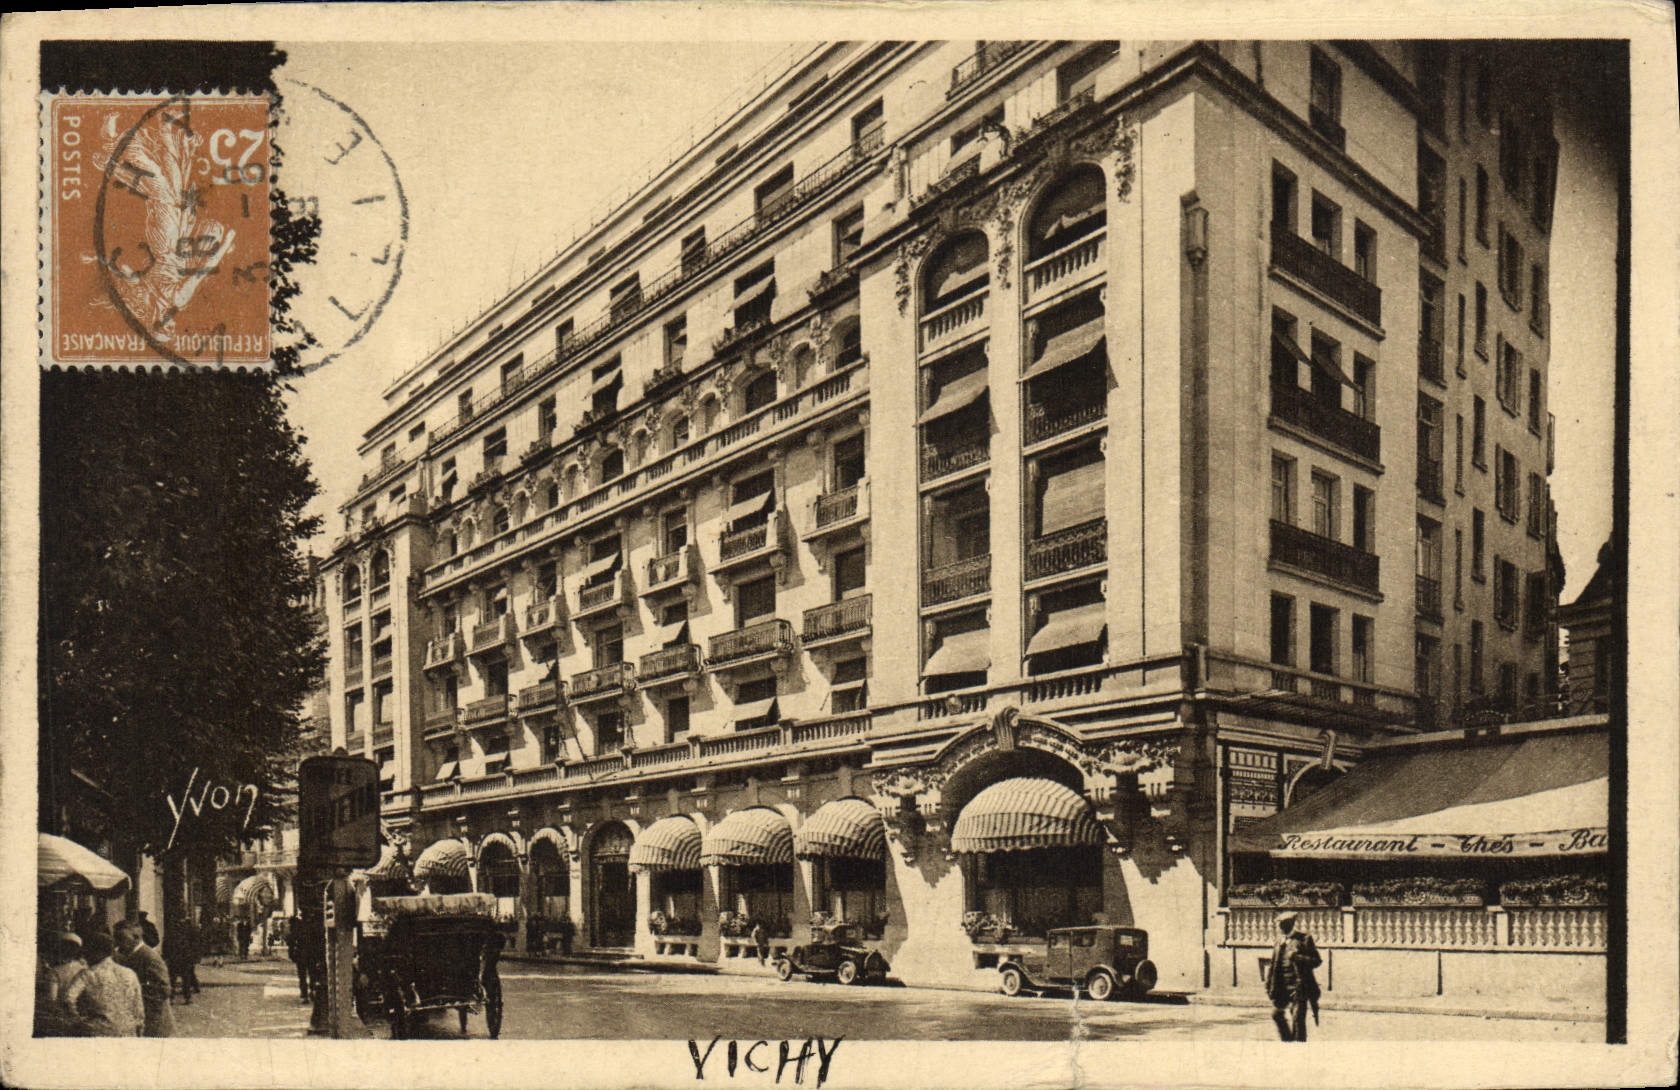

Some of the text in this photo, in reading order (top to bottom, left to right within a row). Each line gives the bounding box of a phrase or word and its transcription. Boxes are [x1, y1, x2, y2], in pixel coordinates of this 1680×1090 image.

[62, 115, 81, 201] POSTES
[209, 128, 266, 187] 25
[62, 333, 148, 352] FRANÇAISE
[1277, 834, 1427, 853] Restaurant
[687, 1034, 847, 1090] VICHY
